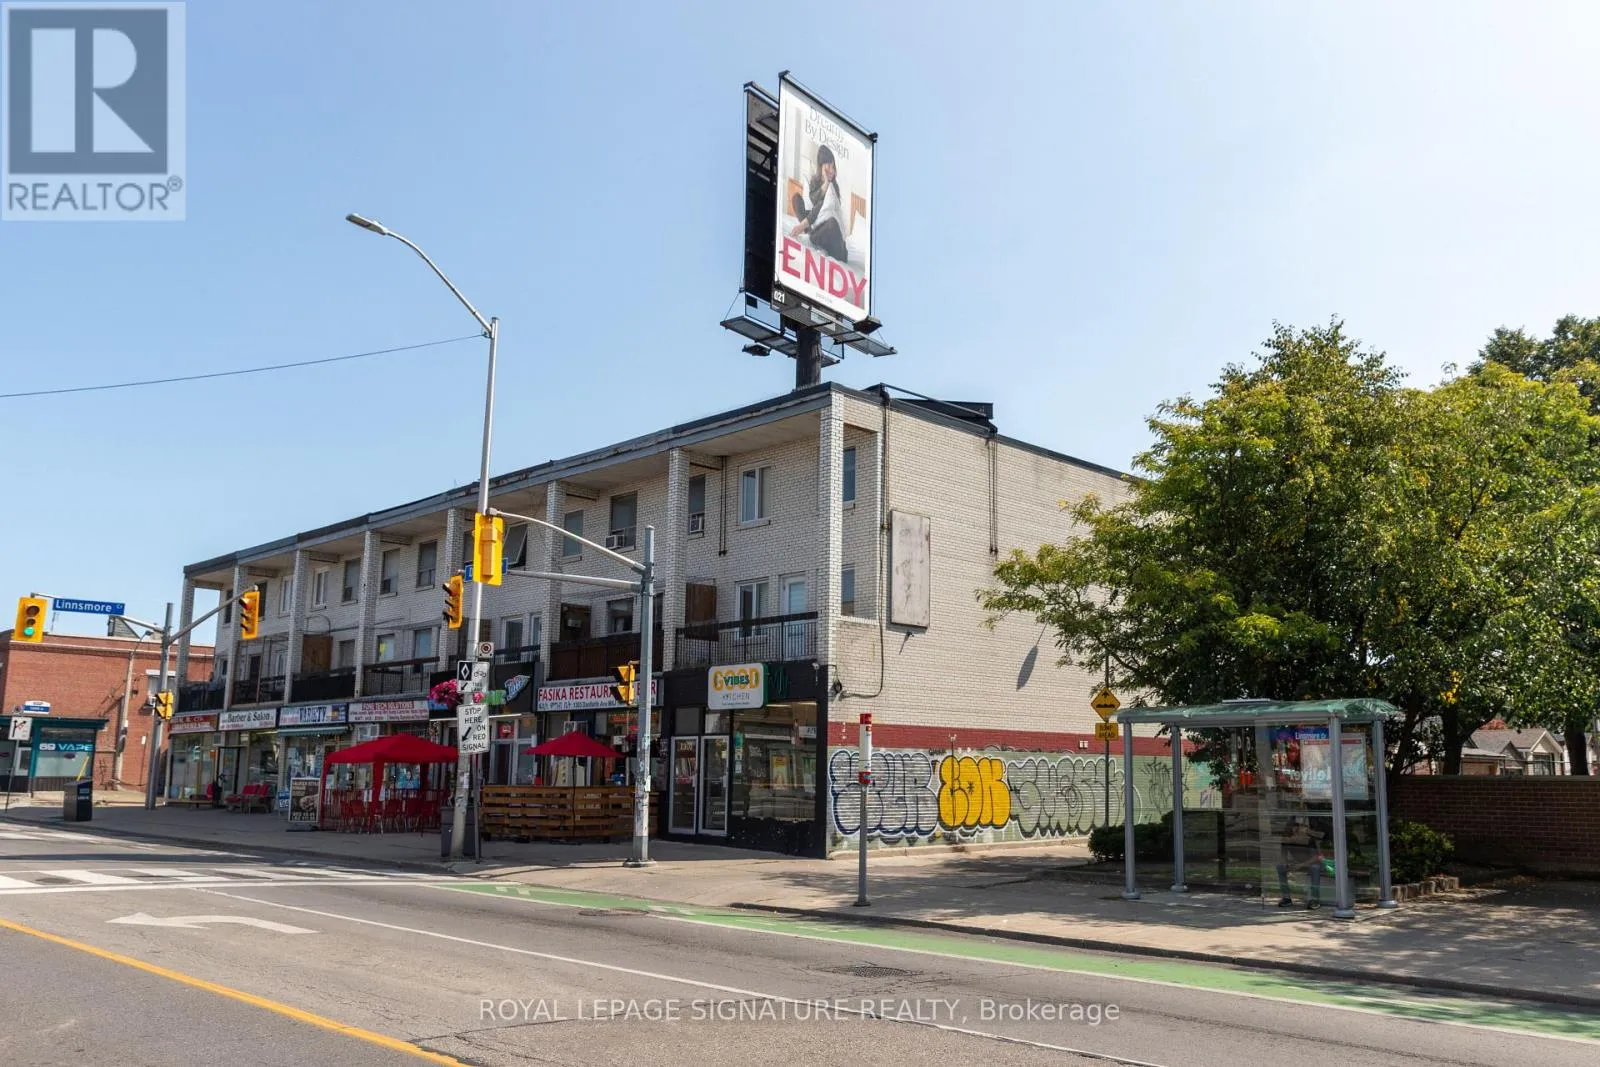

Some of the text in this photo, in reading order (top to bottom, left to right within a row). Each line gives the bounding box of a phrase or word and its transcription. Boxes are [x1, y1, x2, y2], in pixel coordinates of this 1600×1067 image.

[781, 234, 867, 310] ENDY
[55, 599, 112, 612] Linnsmore
[713, 668, 760, 691] GOOD
[723, 674, 750, 687] VIBES
[539, 687, 567, 701] FASIKA
[465, 708, 481, 716] STOP
[464, 716, 482, 724] HERE
[472, 733, 486, 741] RED
[58, 743, 94, 751] VAPE
[462, 742, 486, 751] SIGNAL
